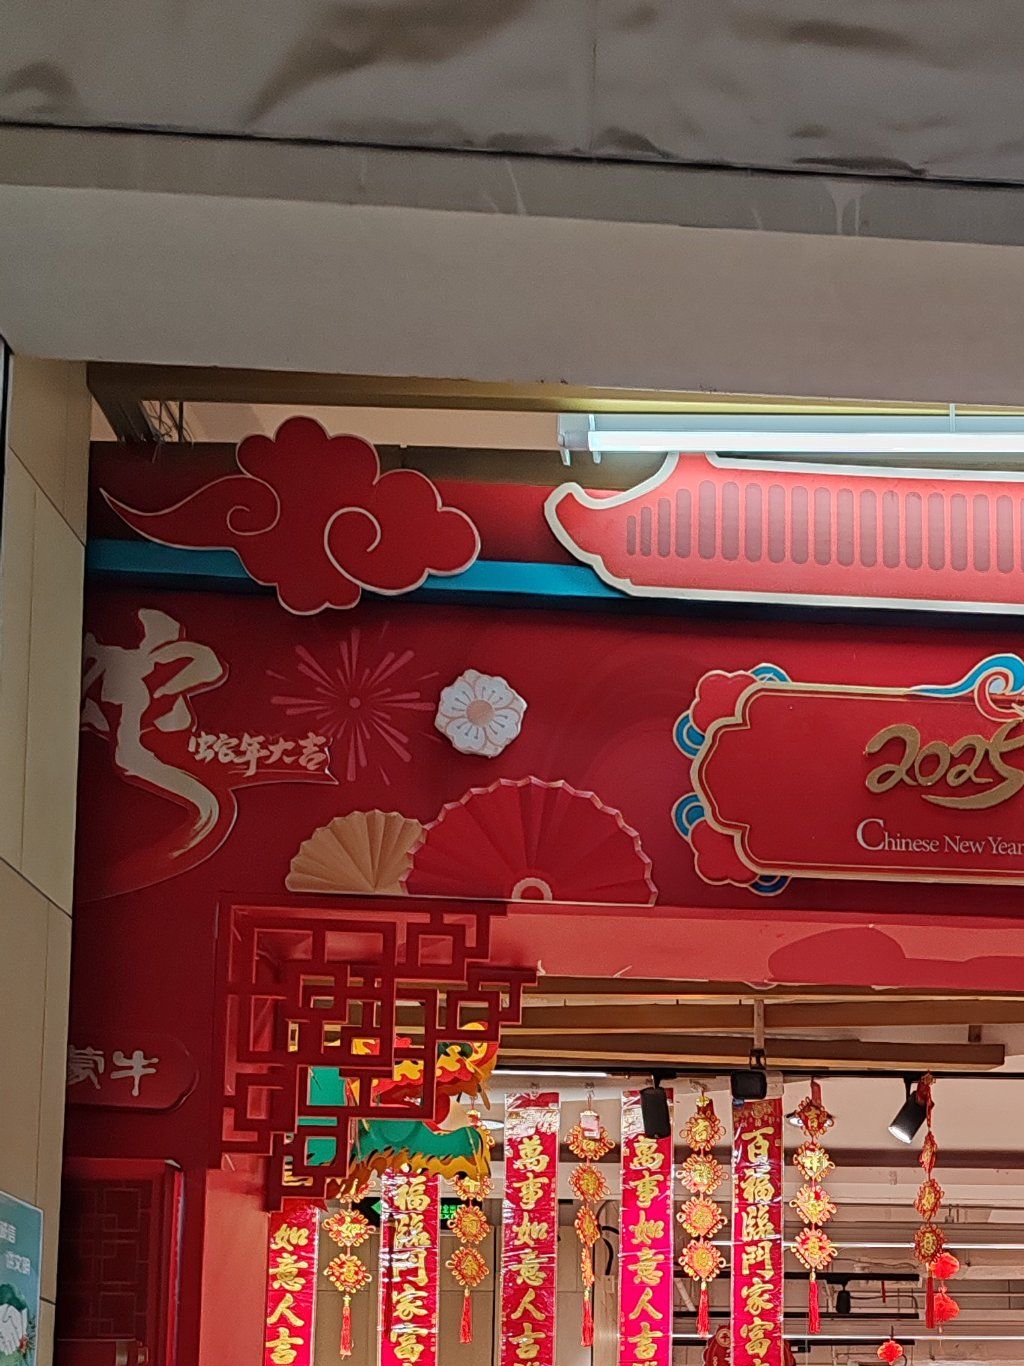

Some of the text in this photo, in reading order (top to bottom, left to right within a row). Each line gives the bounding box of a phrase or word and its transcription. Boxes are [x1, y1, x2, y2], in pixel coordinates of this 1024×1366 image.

[187, 731, 329, 775] 蛇年大吉
[855, 818, 939, 855] Chinese
[943, 836, 985, 856] New
